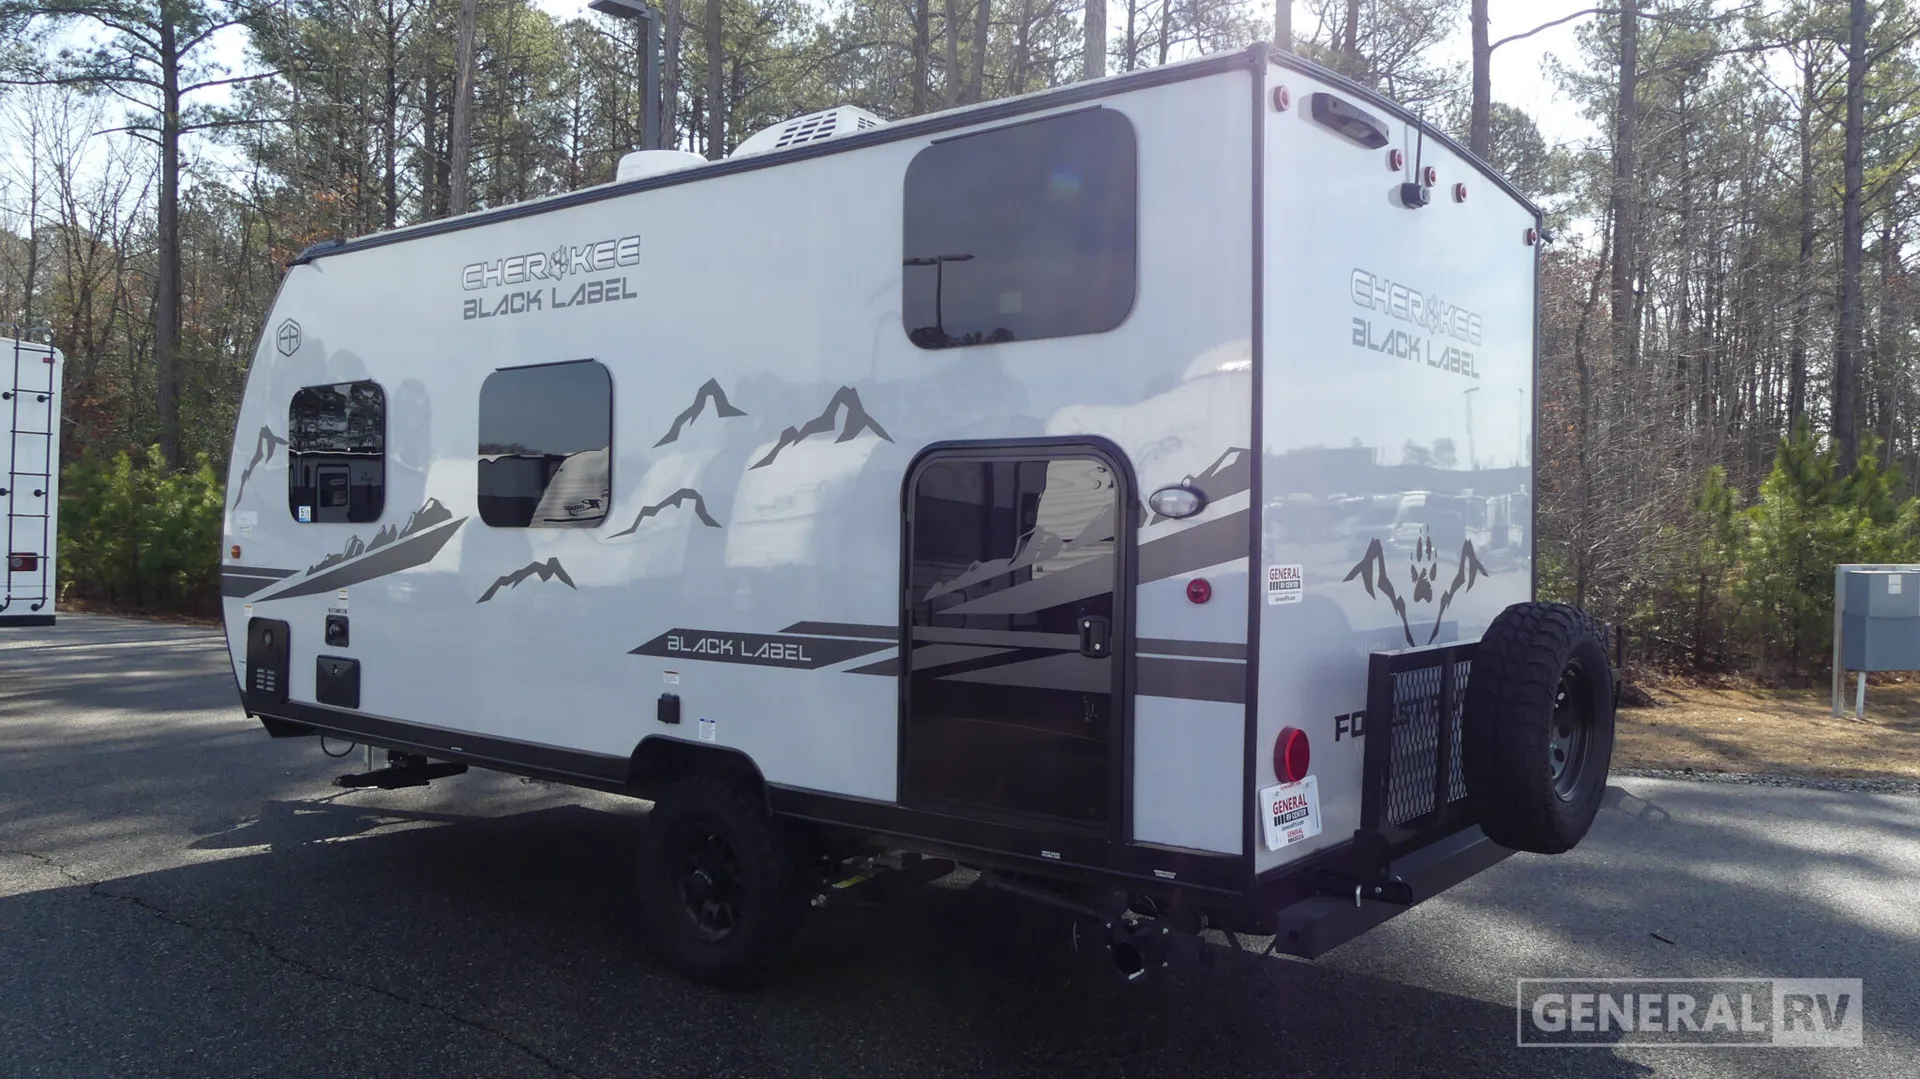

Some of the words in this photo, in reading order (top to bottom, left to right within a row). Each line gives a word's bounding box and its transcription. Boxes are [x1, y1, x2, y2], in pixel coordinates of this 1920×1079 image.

[463, 289, 543, 321] BLACK
[552, 276, 638, 309] LABEL
[1352, 316, 1421, 363] BLACK
[1426, 339, 1481, 379] LABEL
[1269, 567, 1301, 581] GENERAL
[667, 635, 734, 656] BLACK
[741, 640, 812, 662] LABEL
[1273, 793, 1307, 815] GENERAL
